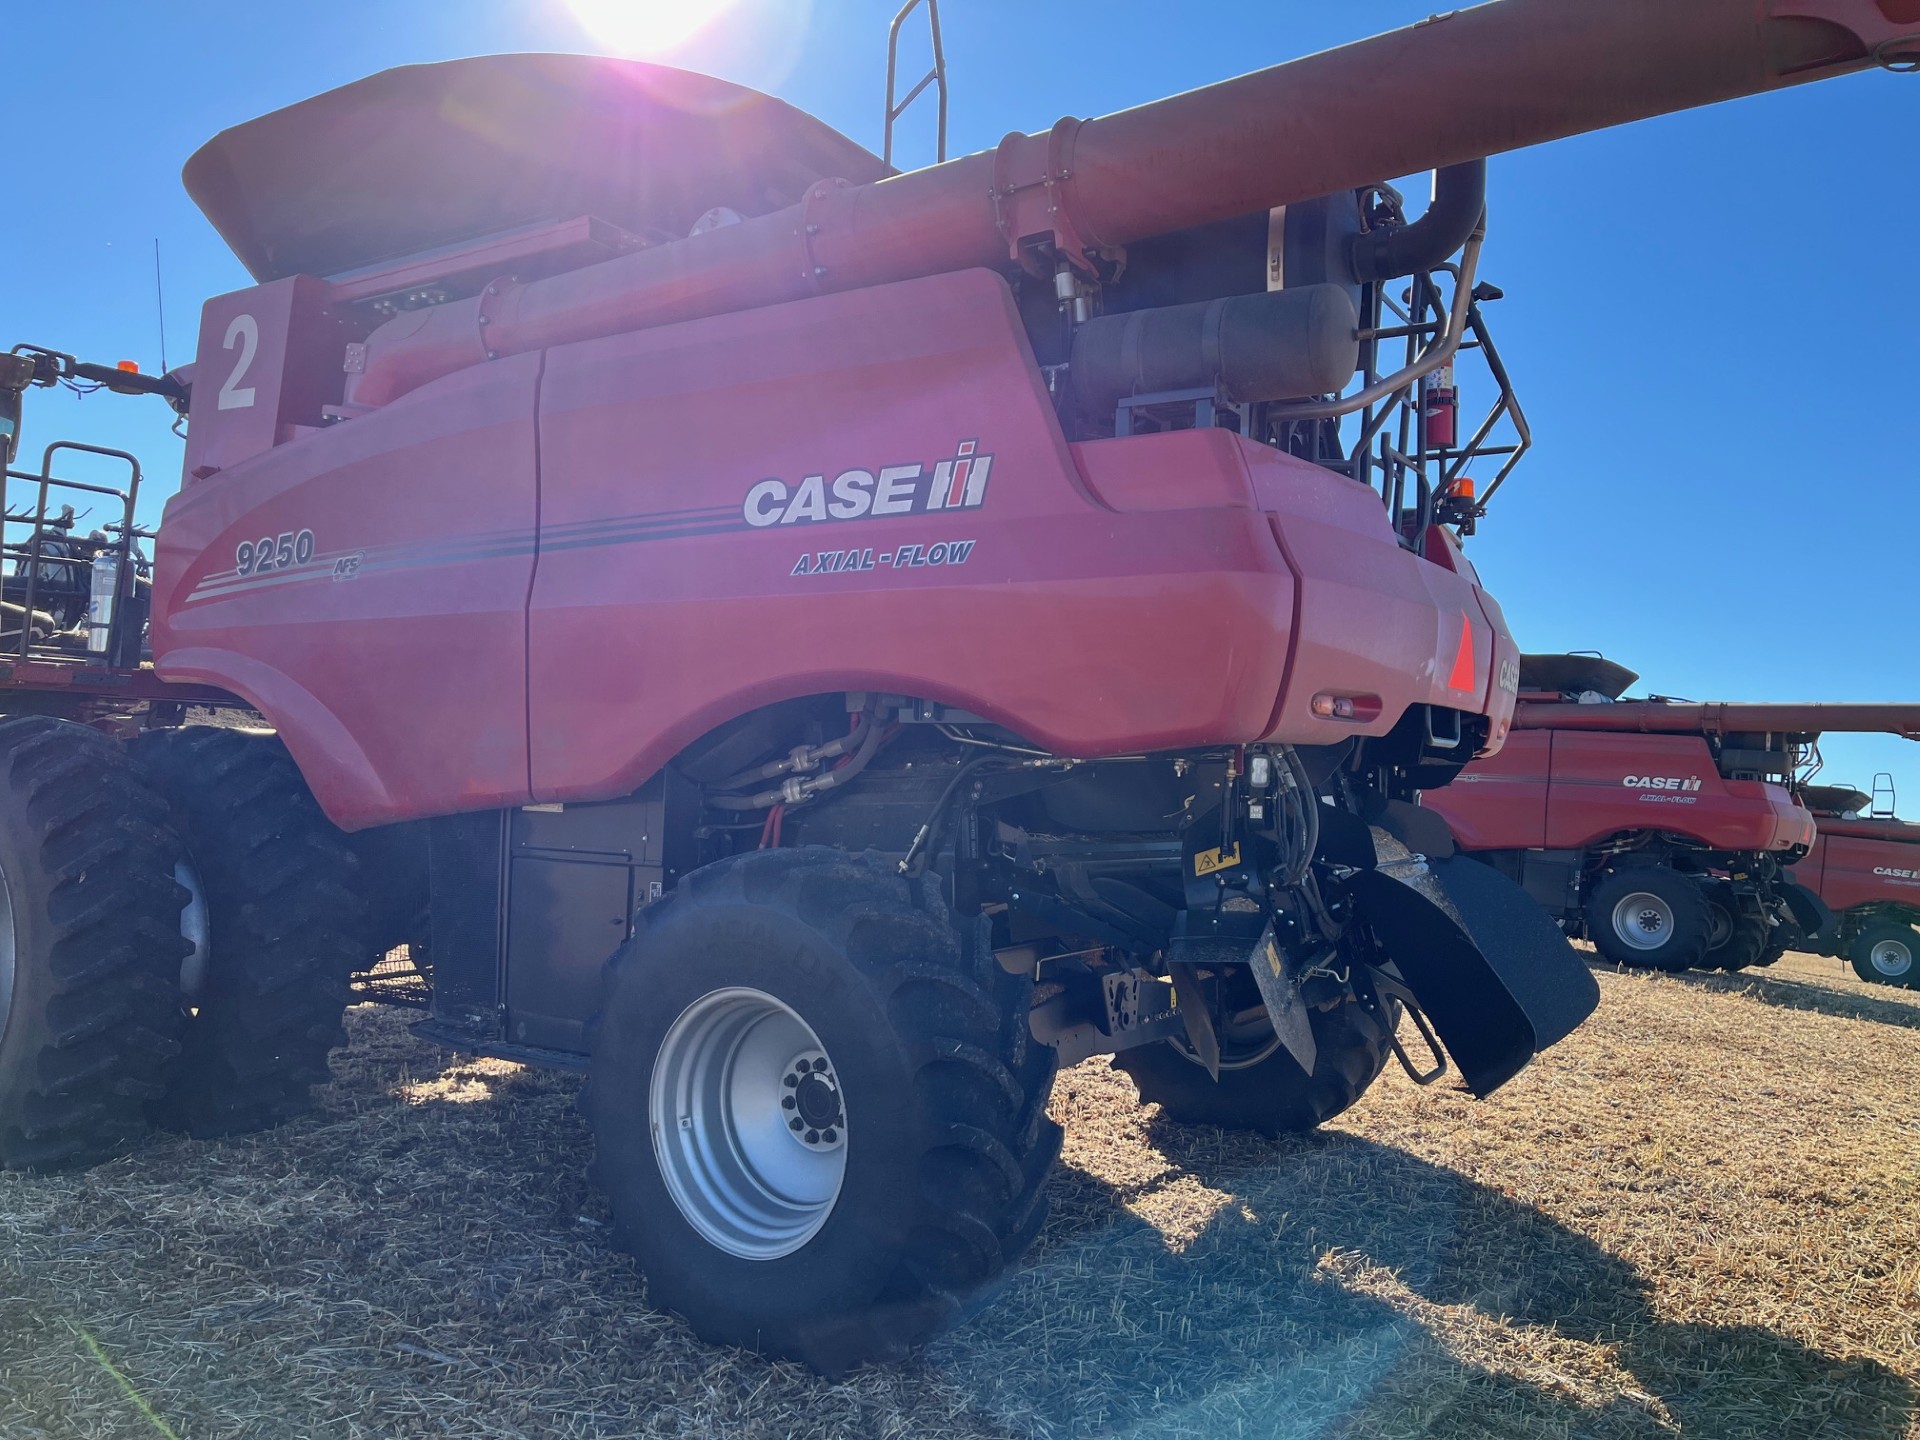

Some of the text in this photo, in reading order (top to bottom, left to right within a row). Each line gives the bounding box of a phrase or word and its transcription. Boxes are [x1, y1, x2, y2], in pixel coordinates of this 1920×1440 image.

[218, 314, 258, 410] 2
[743, 464, 922, 527] CASE
[236, 528, 314, 576] 9250
[1622, 775, 1681, 790] CASE
[1872, 866, 1911, 878] CASE
